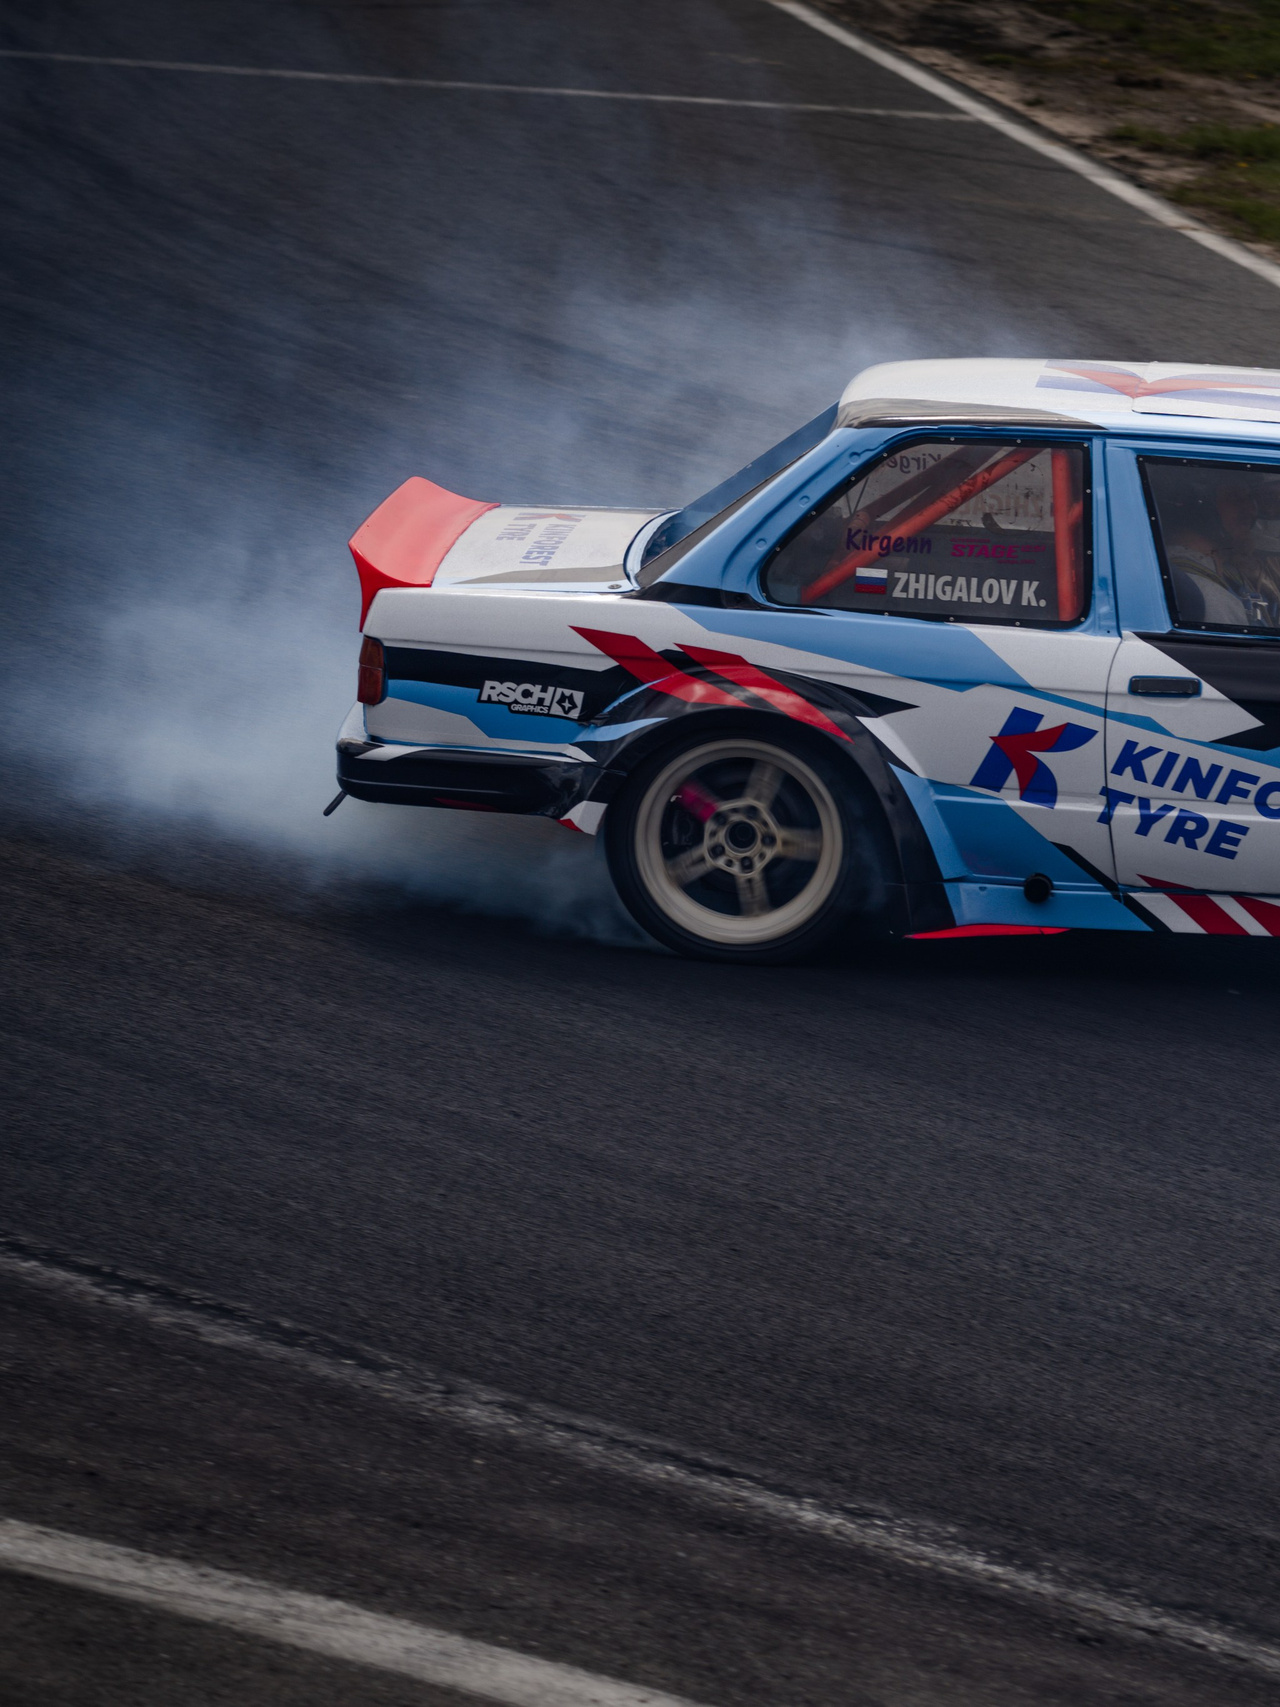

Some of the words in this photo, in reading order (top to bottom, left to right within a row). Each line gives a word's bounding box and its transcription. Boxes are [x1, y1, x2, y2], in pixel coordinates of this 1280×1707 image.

[496, 523, 537, 541] TYRE
[519, 523, 577, 566] KINFOREST
[846, 528, 932, 557] Kirgenn
[950, 544, 1019, 558] STAGE
[892, 571, 1018, 605] ZHIGALOV
[1021, 579, 1047, 607] K.
[480, 680, 556, 706] RSCH
[510, 703, 550, 714] GRAPHICS
[1096, 785, 1250, 860] TYRE
